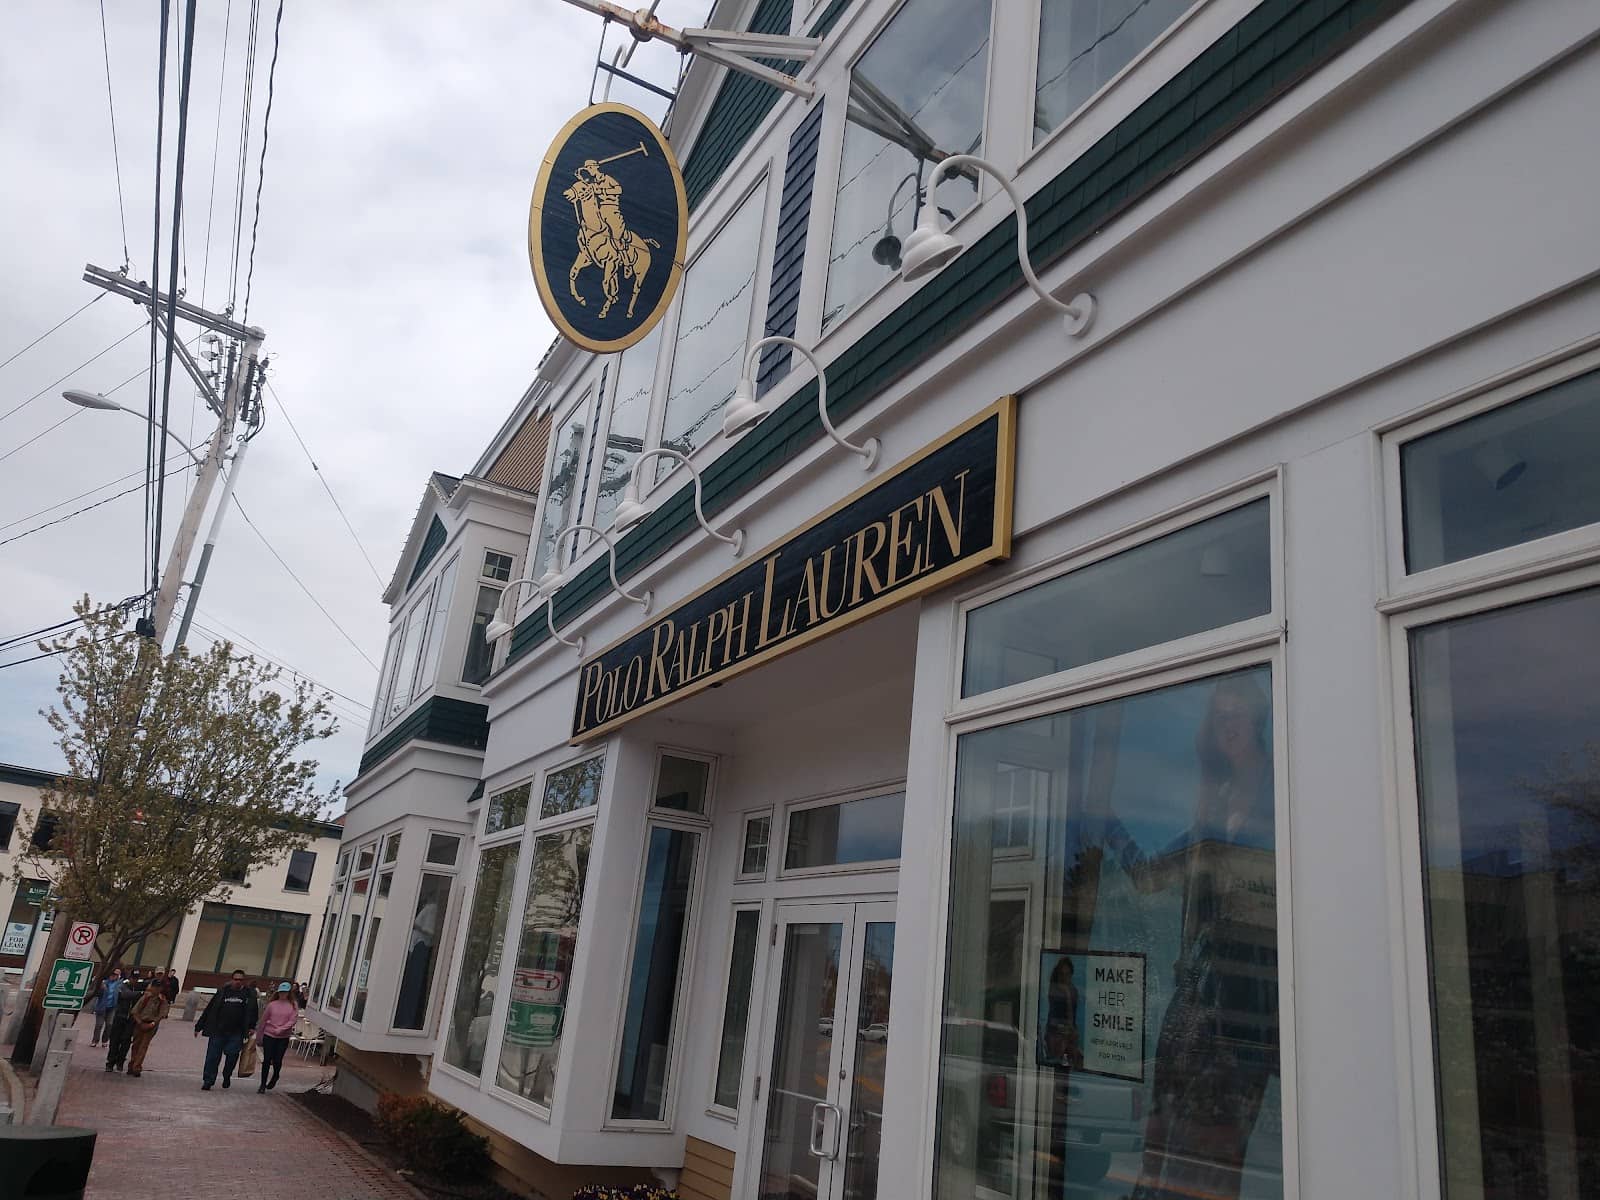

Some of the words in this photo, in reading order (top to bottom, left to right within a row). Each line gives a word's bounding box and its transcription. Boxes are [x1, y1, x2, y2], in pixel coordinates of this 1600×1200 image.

[576, 656, 645, 733] POLO
[645, 591, 753, 702] RALPH
[754, 469, 971, 651] LAUREN
[1095, 967, 1134, 984] MAKE
[1098, 991, 1126, 1007] HER
[1093, 1013, 1134, 1032] SMILE
